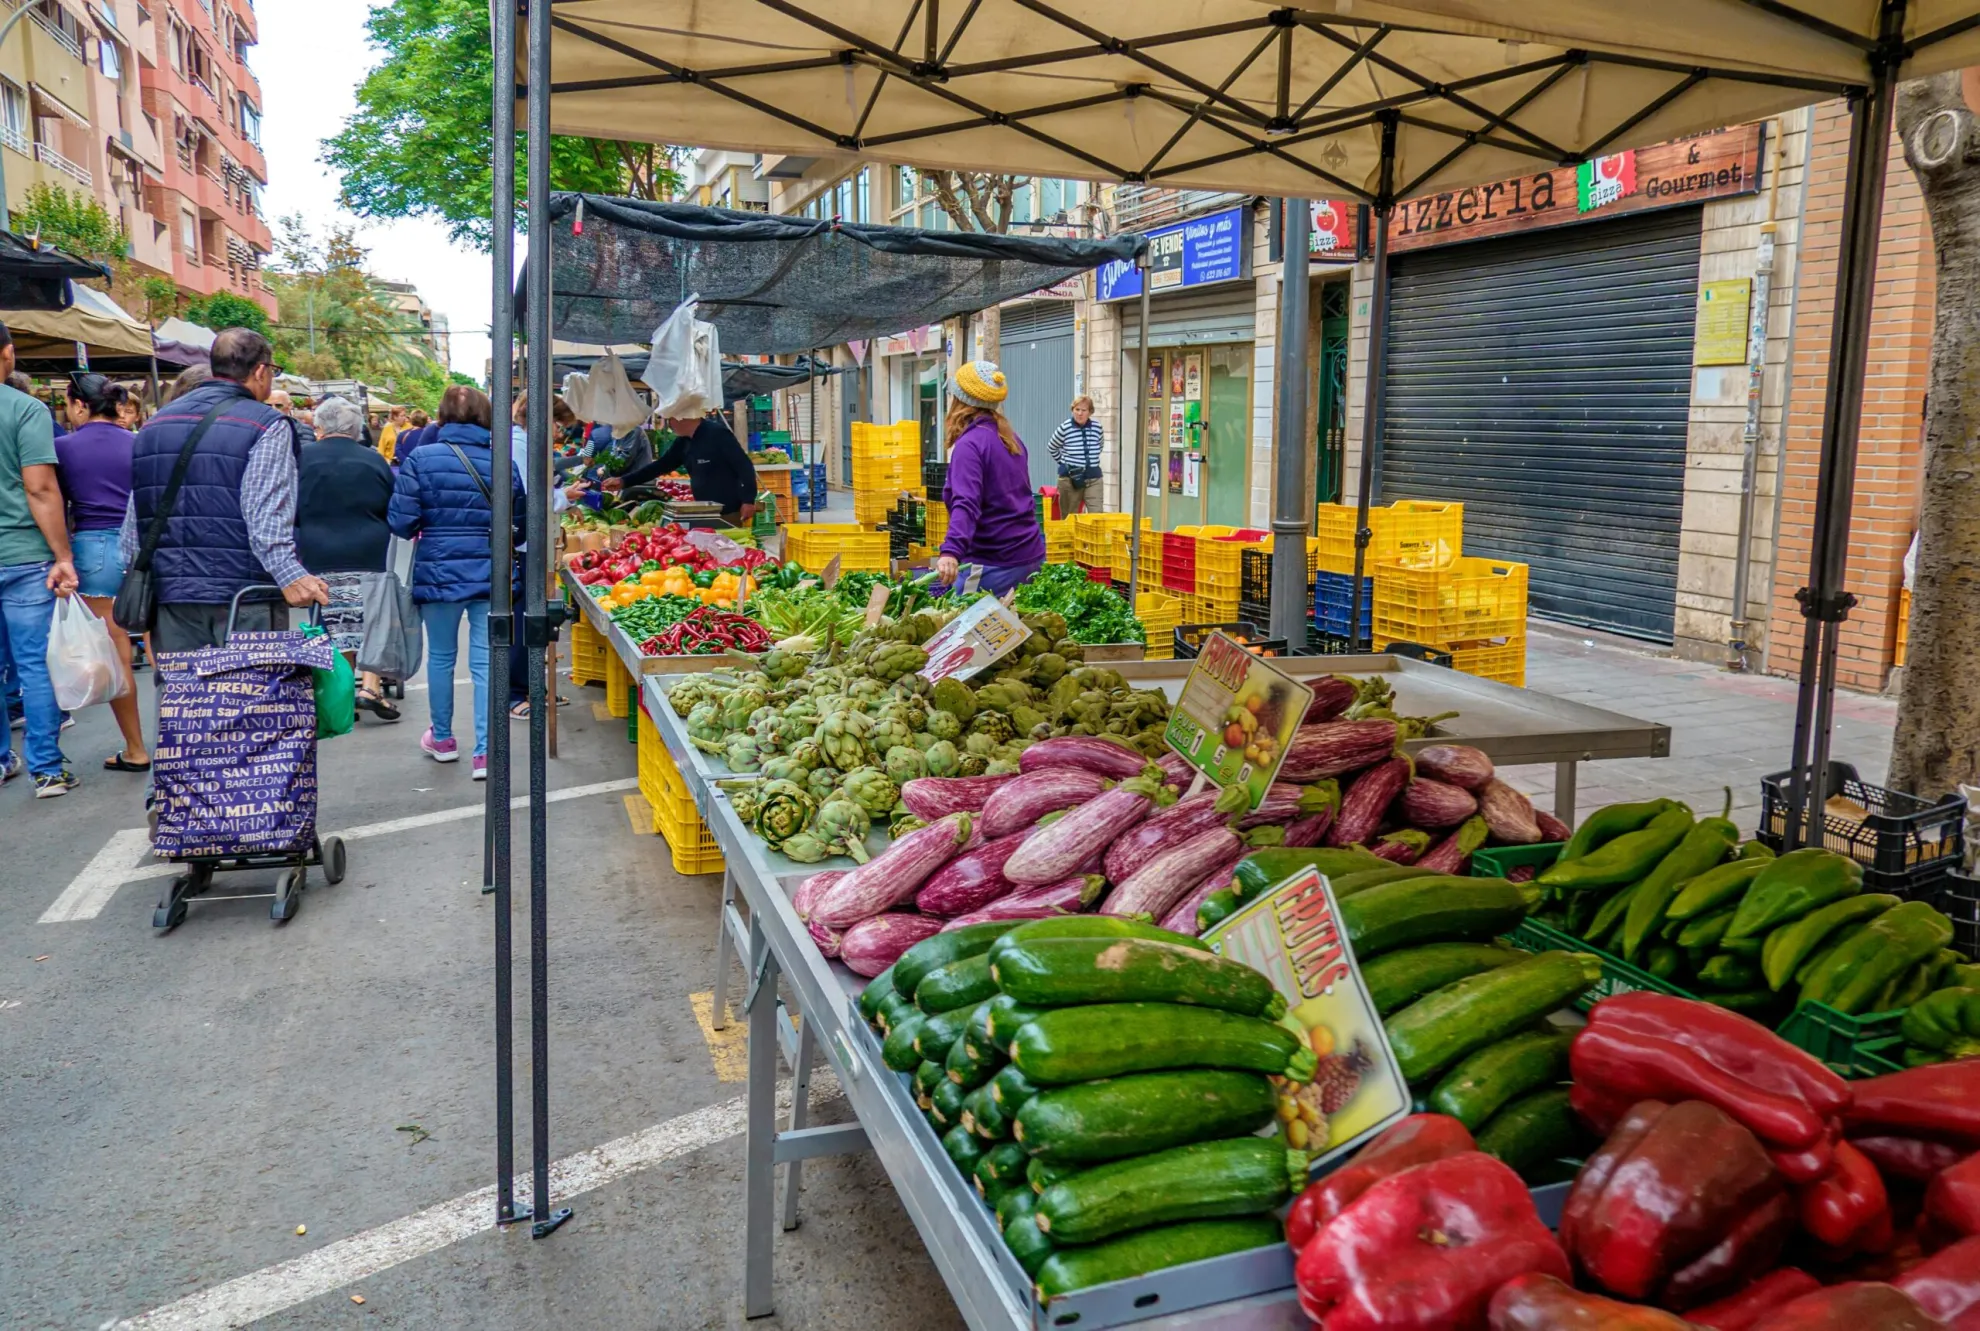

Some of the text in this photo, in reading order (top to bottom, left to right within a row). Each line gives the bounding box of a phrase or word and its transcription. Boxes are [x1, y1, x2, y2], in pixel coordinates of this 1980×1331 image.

[1688, 143, 1700, 165] &
[1646, 162, 1742, 198] Gourmet
[1590, 182, 1623, 206] pizza
[1160, 232, 1183, 255] VENDE
[1039, 289, 1074, 297] MEDIDA
[229, 632, 278, 642] TOKIO
[157, 651, 198, 660] NDON
[247, 651, 287, 660] SEVILLA
[1199, 634, 1252, 693] FRUTAS
[158, 660, 188, 672] erdam
[161, 672, 199, 682] NEZIA
[163, 683, 205, 695] OSKVA
[182, 706, 212, 718] boston
[160, 714, 316, 732] ERLIN MILANO LONDO
[172, 729, 315, 744] TOKIO CHICAG
[1170, 725, 1190, 748] KILO
[154, 740, 312, 759] EVILLA frankfurt barce
[154, 760, 189, 771] ONDON
[195, 755, 238, 766] moskva
[246, 751, 294, 763] venezia
[222, 766, 249, 779] SAN
[168, 780, 220, 794] OKIO
[225, 775, 288, 789] BARCELONA
[198, 791, 238, 805] NEW
[225, 801, 294, 817] MILANO
[187, 820, 217, 831] PISA
[221, 815, 275, 832] MIAMI
[154, 836, 181, 846] STON
[239, 828, 294, 843] amsterdam
[1273, 874, 1350, 999] FRUTAS
